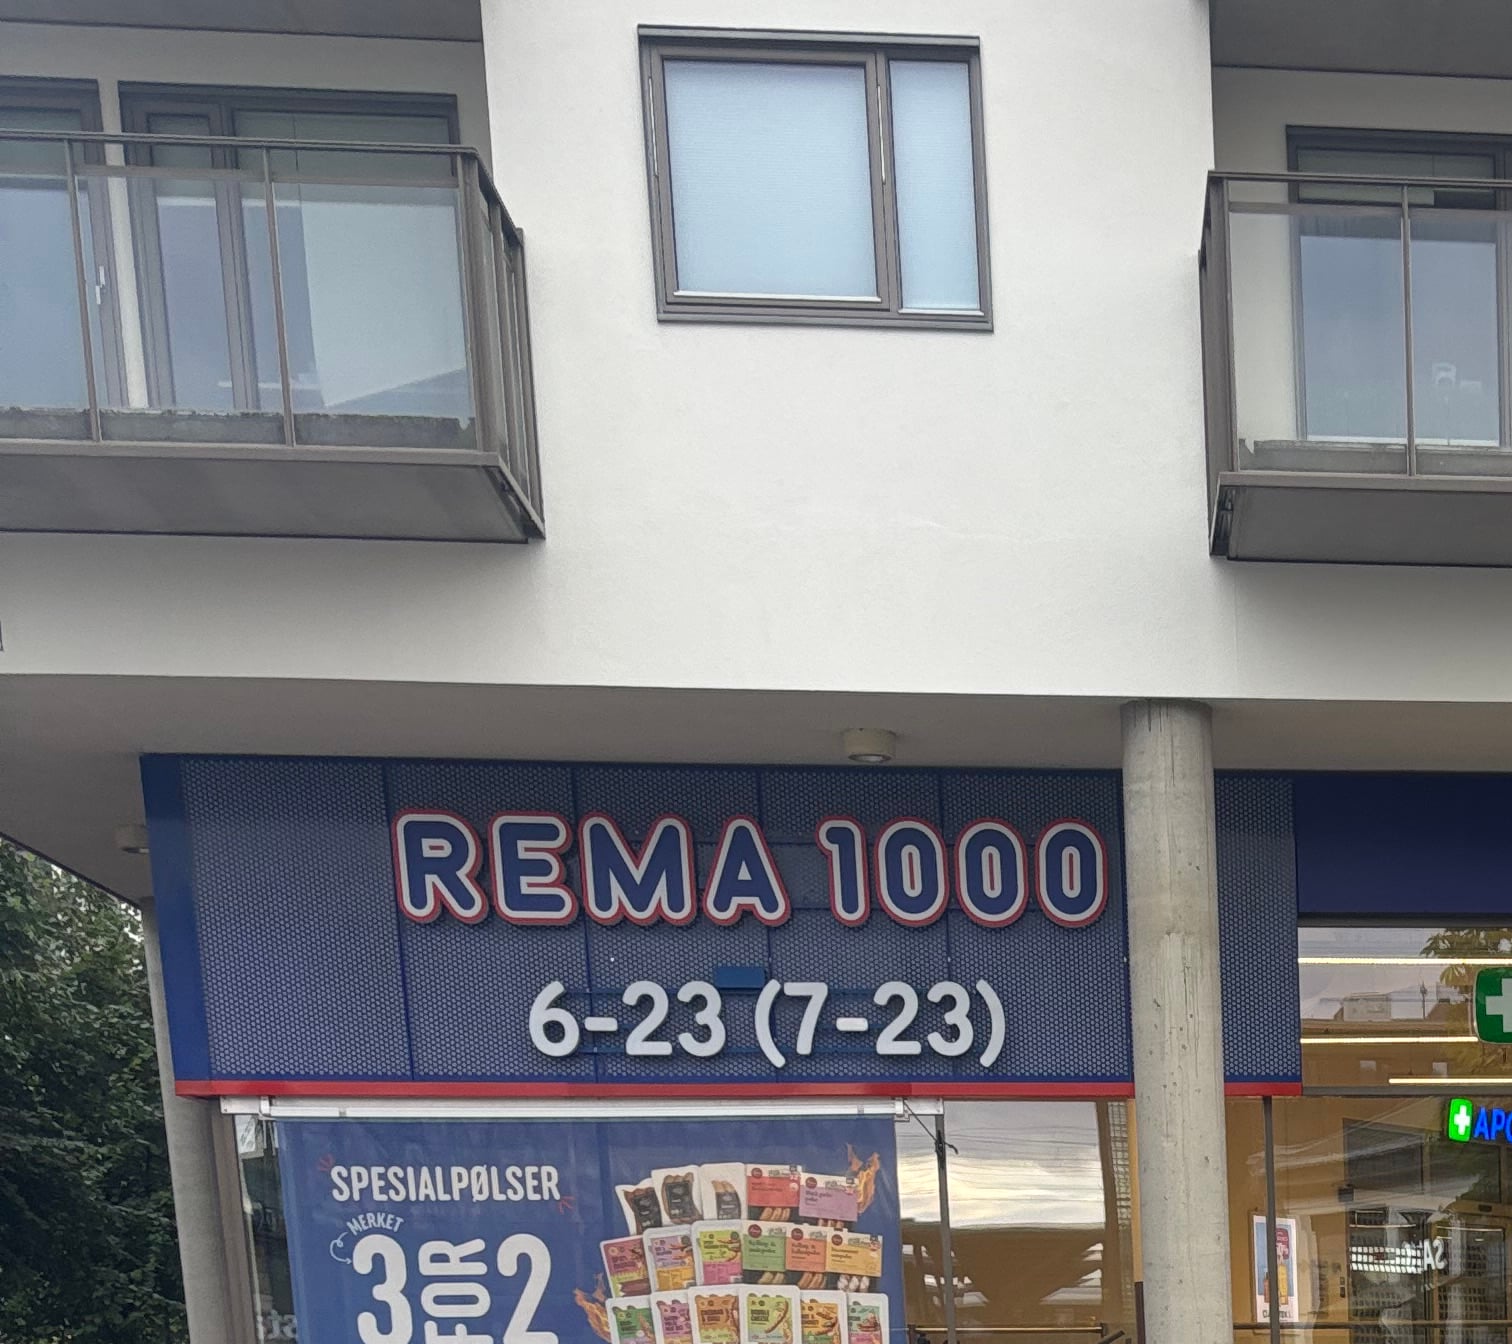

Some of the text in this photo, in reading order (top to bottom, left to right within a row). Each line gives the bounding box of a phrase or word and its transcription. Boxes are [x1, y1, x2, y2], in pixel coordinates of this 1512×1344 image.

[393, 812, 1107, 928] REMA 1000
[529, 979, 1006, 1068] 6-23 (7-23)
[331, 1164, 560, 1202] SPESIALPØLSER
[347, 1212, 404, 1236] MERKET
